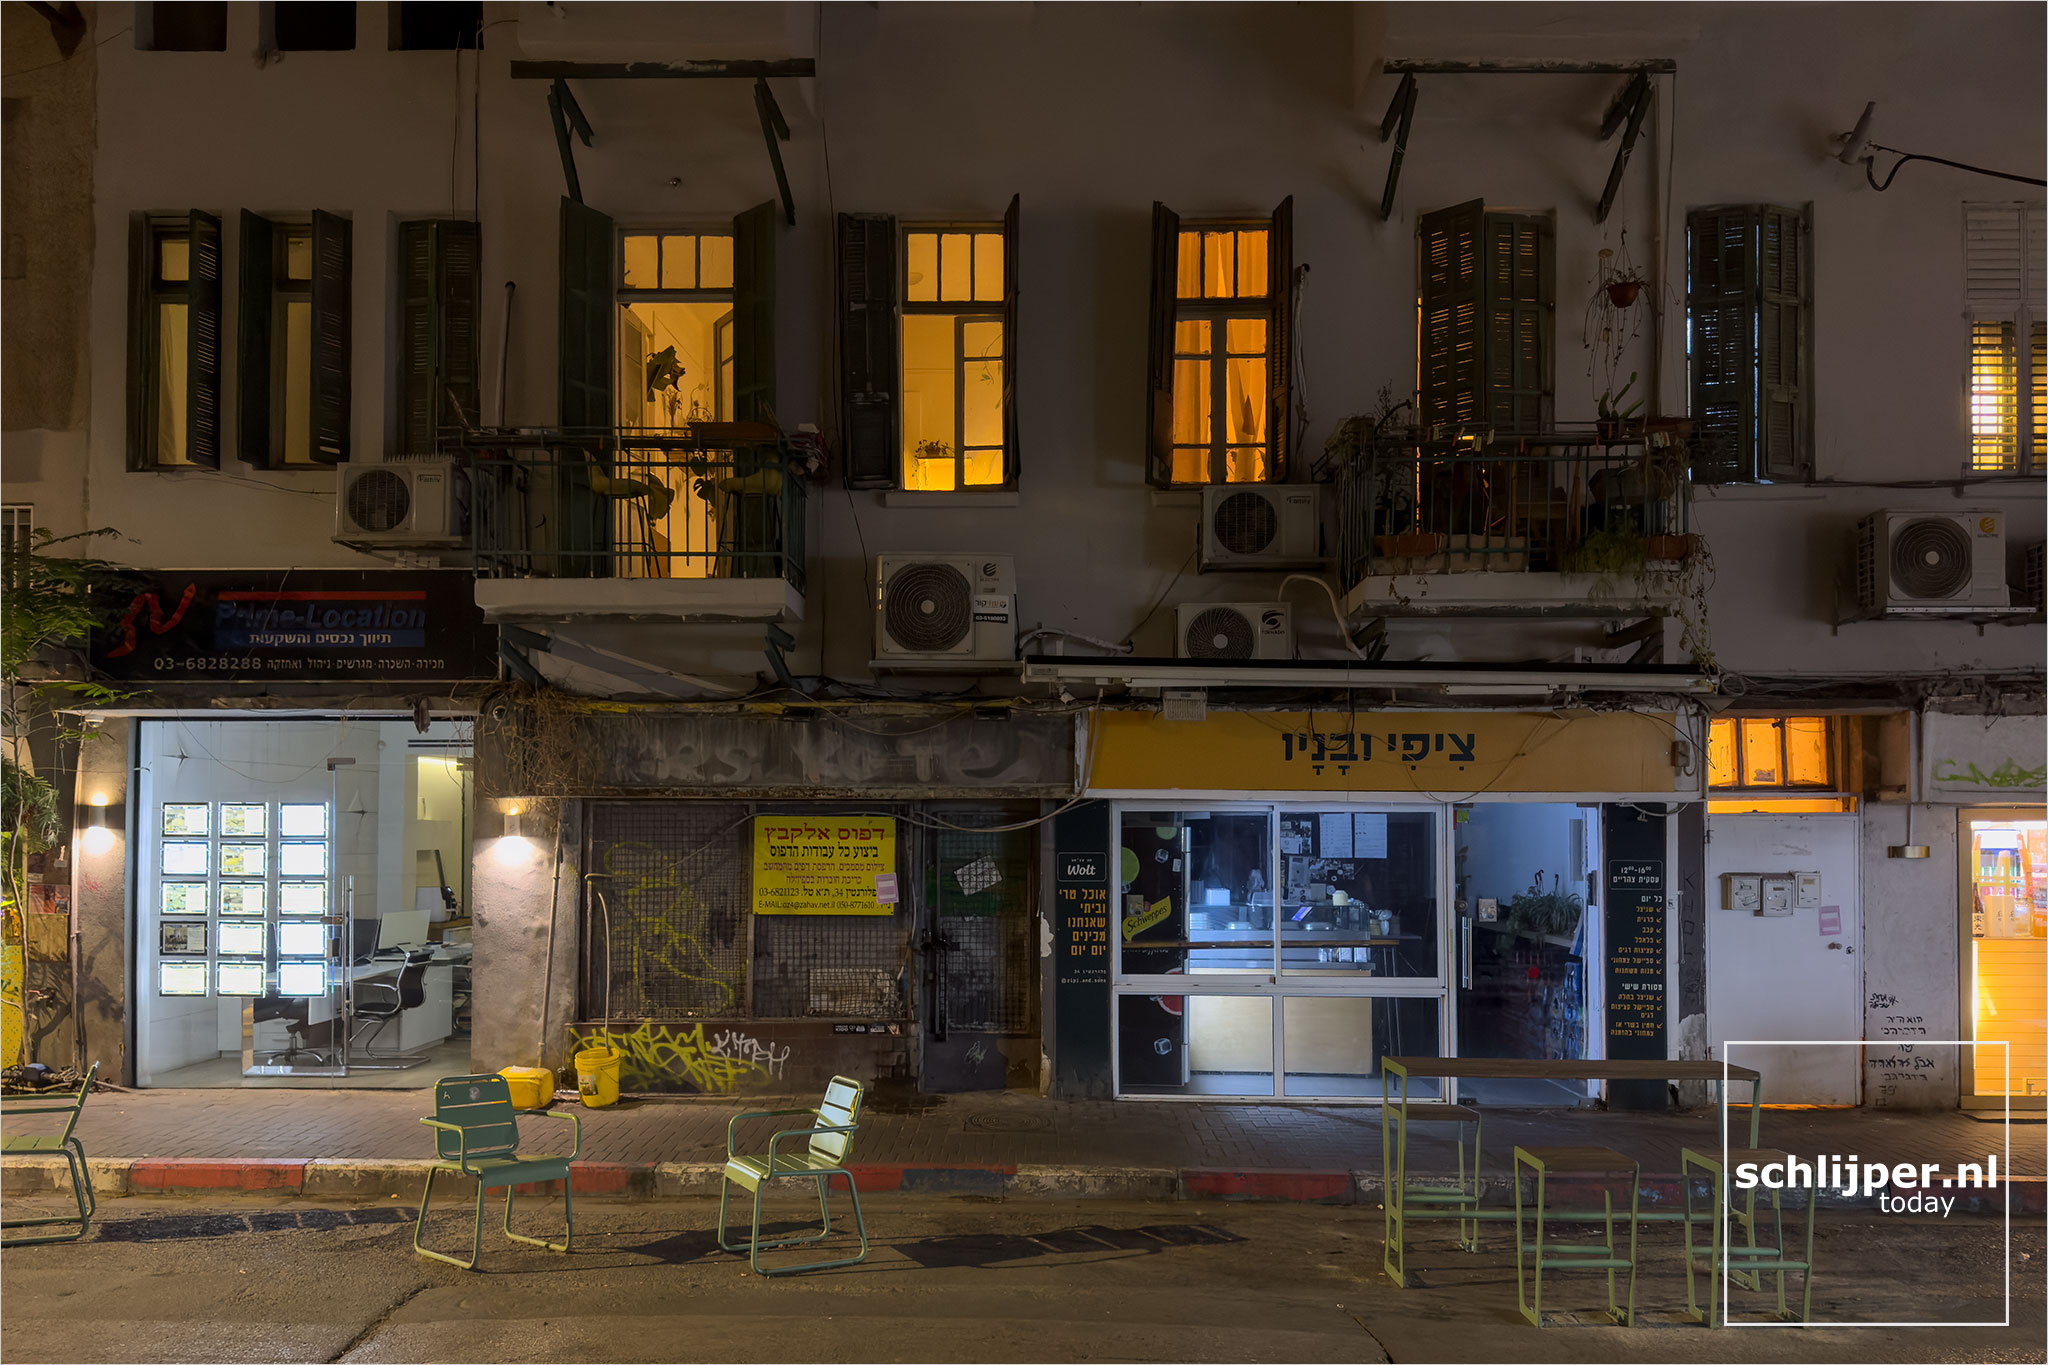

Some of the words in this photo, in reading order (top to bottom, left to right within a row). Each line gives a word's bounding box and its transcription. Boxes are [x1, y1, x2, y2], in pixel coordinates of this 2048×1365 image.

[249, 633, 311, 647] והשקעות
[315, 633, 355, 644] נכסים
[360, 633, 392, 647] תיווך
[153, 657, 262, 671] 03-6828288
[267, 658, 303, 671] ואחזקה
[764, 823, 831, 843] אלקבץ
[838, 827, 885, 841] דפוס
[770, 845, 799, 858] הדפוס
[801, 845, 835, 859] עבודות
[838, 841, 851, 858] כל
[853, 845, 879, 859] ביצוע
[1067, 864, 1097, 876] Wolt
[1638, 876, 1660, 884] עסקית
[758, 887, 800, 898] 03-6821123
[846, 886, 877, 899] פלורנטין
[1059, 889, 1077, 900] טרי
[1082, 887, 1107, 900] אוכל
[1641, 895, 1652, 903] יום
[1654, 895, 1663, 903] כל
[1080, 903, 1106, 914] וביתי
[1067, 917, 1106, 928] שאנחנו
[1127, 905, 1168, 933] Schweppes
[1072, 931, 1106, 942] מכינים
[1071, 945, 1086, 956] יום
[1091, 945, 1107, 956] יום
[1914, 1056, 1935, 1070] אבל
